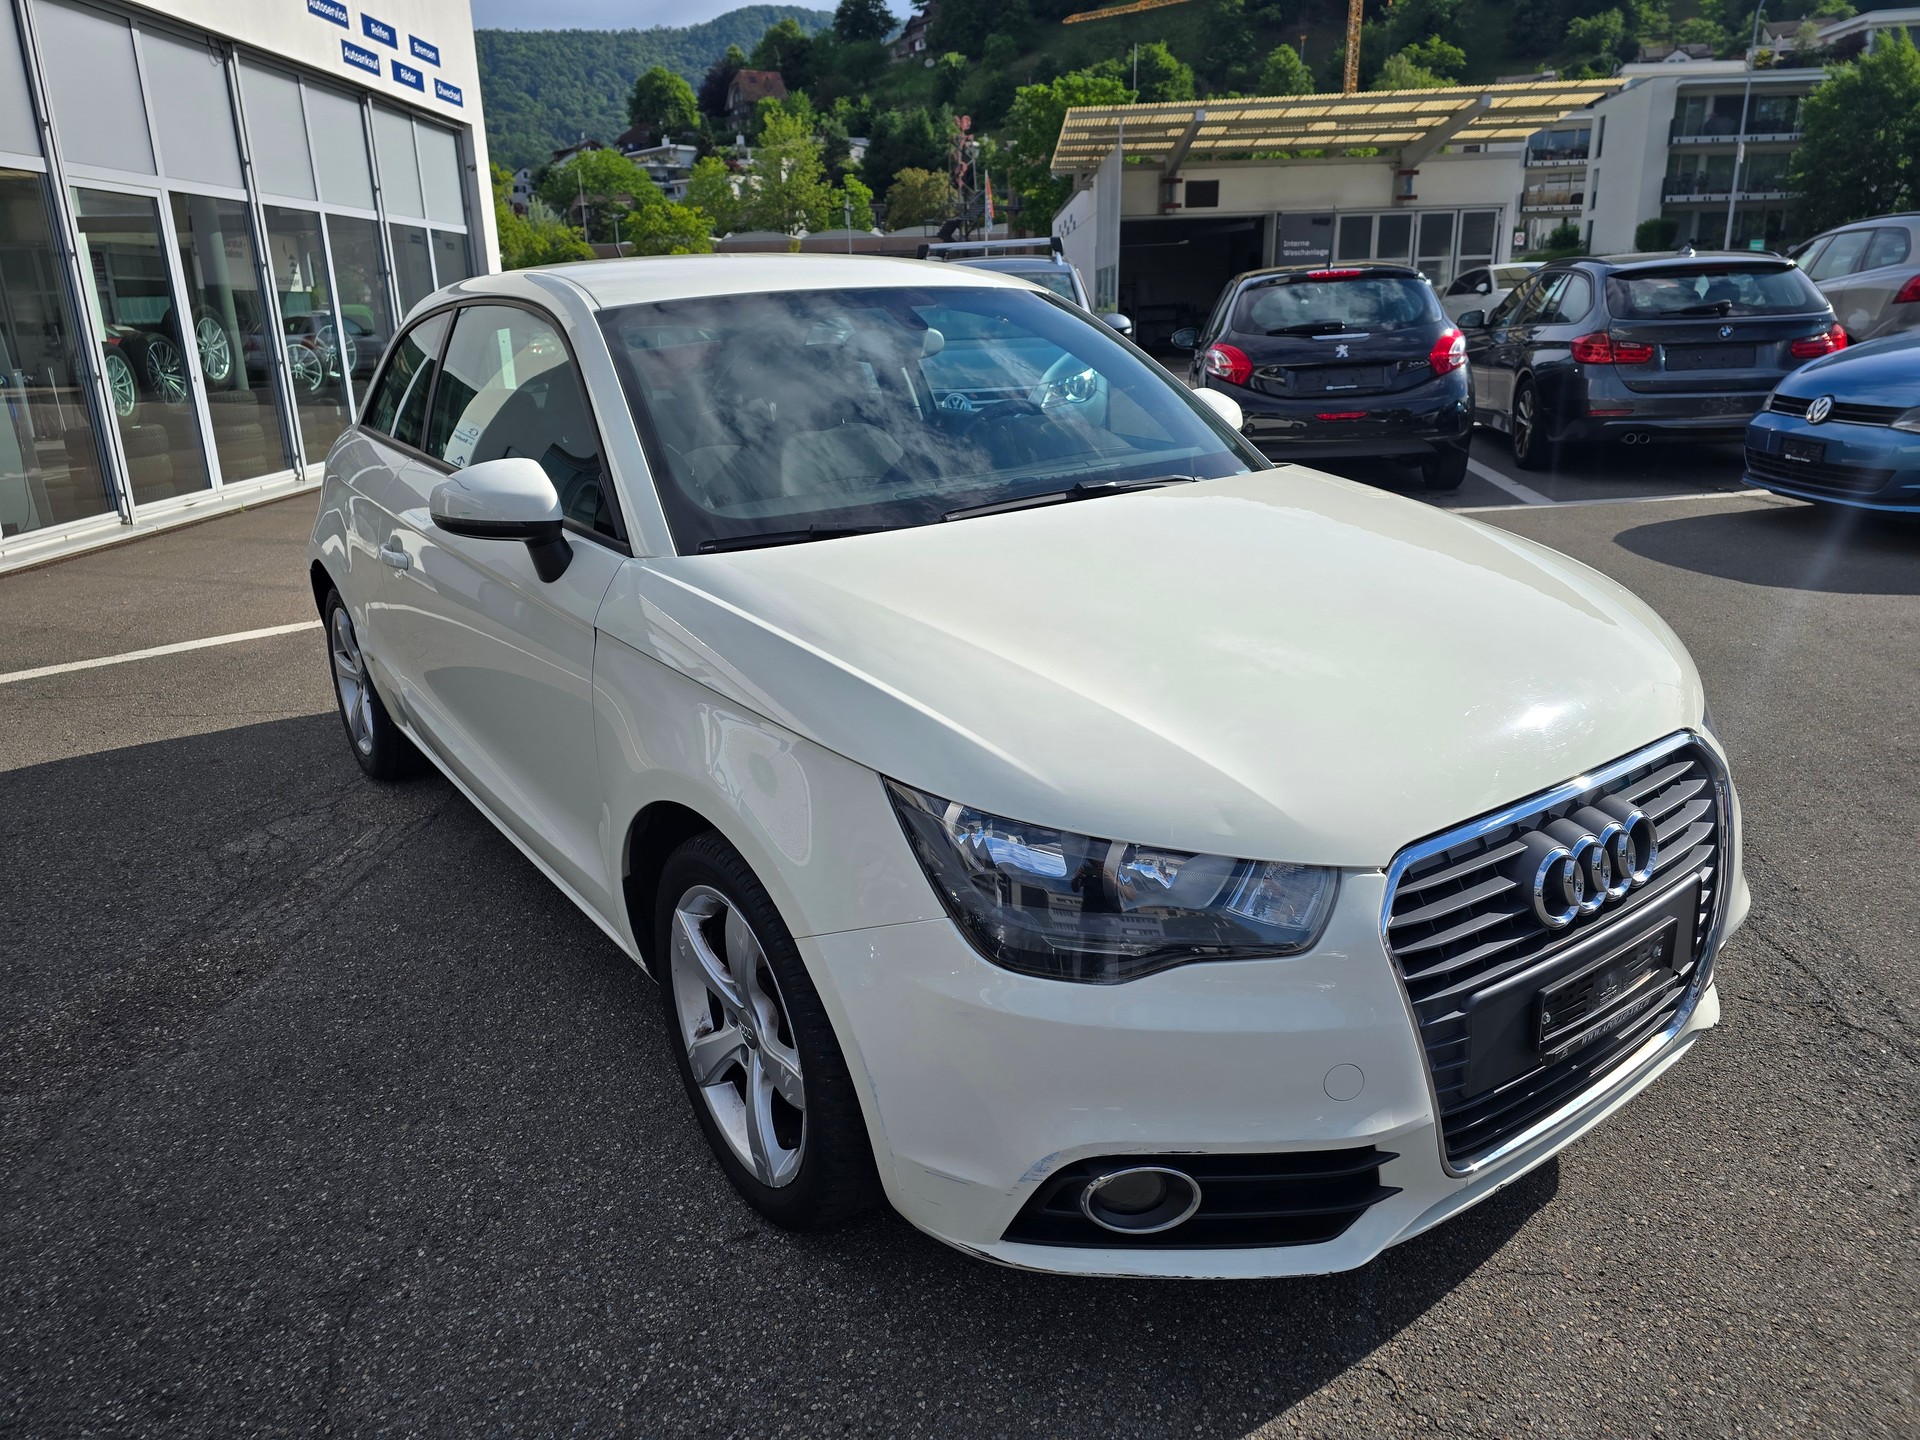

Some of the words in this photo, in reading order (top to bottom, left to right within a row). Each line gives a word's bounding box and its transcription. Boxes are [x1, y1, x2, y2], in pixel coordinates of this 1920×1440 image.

[370, 23, 390, 41] Reifen
[344, 46, 379, 70] Autoankauf
[413, 42, 437, 60] Bremsen
[400, 67, 417, 84] Räder
[1283, 249, 1329, 257] Waschanlage
